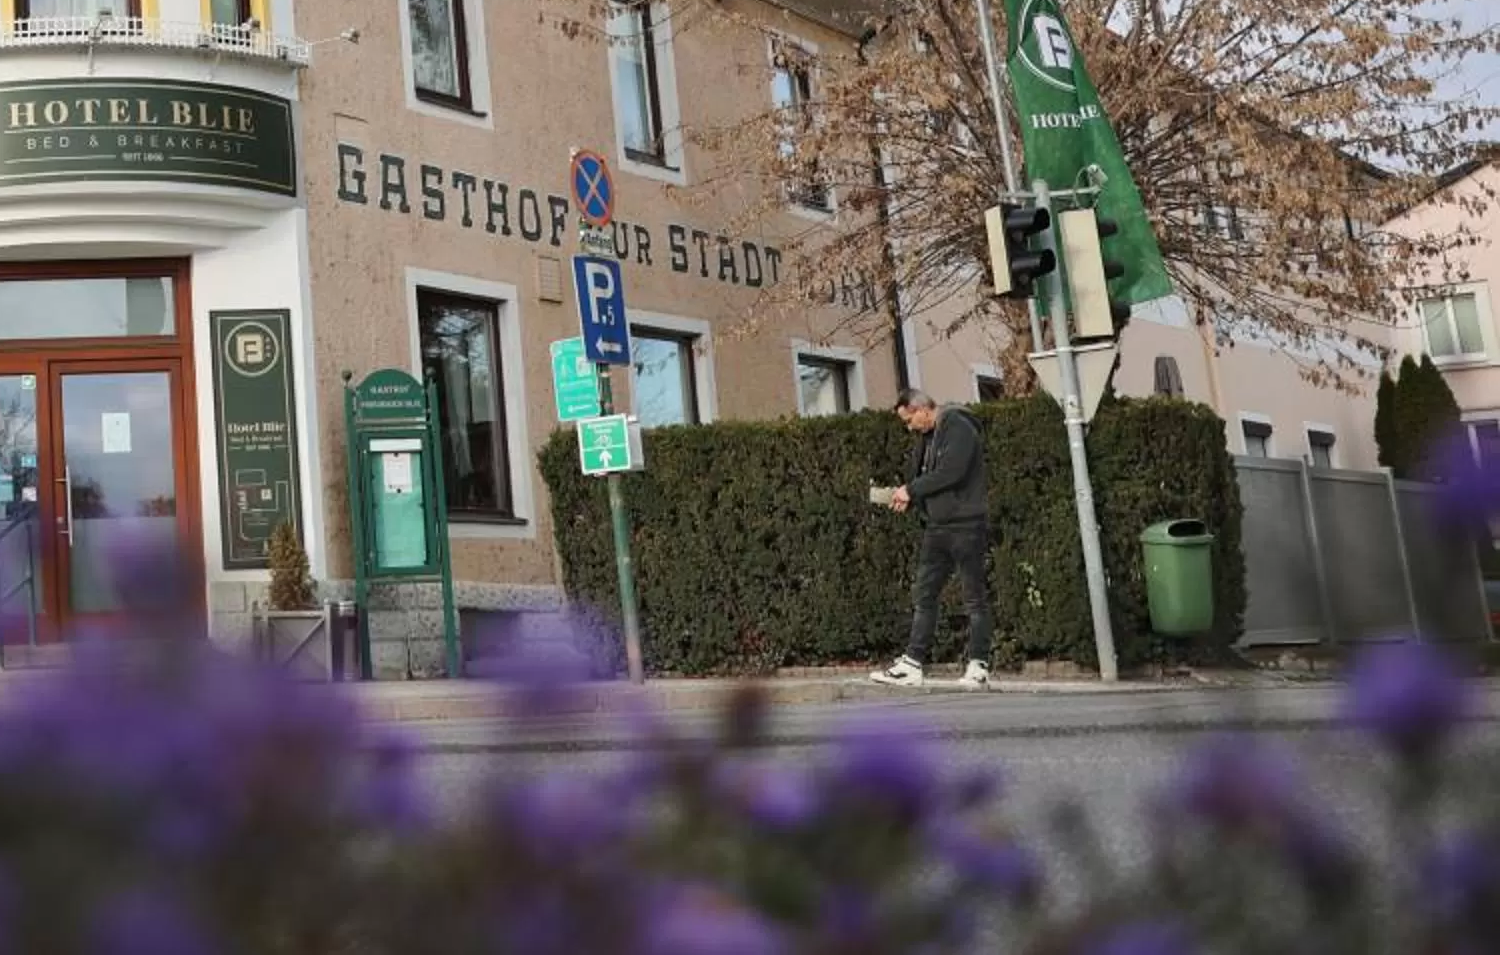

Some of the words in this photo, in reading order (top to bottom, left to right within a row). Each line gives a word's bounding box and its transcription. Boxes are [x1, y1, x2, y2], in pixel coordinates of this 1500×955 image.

[7, 98, 158, 128] HOTEL
[170, 100, 256, 133] BLIE
[1030, 112, 1080, 129] HOTE
[26, 136, 70, 150] BED
[89, 136, 99, 147] &
[117, 135, 244, 154] BREAKFAST
[338, 143, 569, 246] GASTHOF
[587, 221, 652, 265] UR
[668, 224, 782, 287] STADT
[585, 263, 614, 324] P
